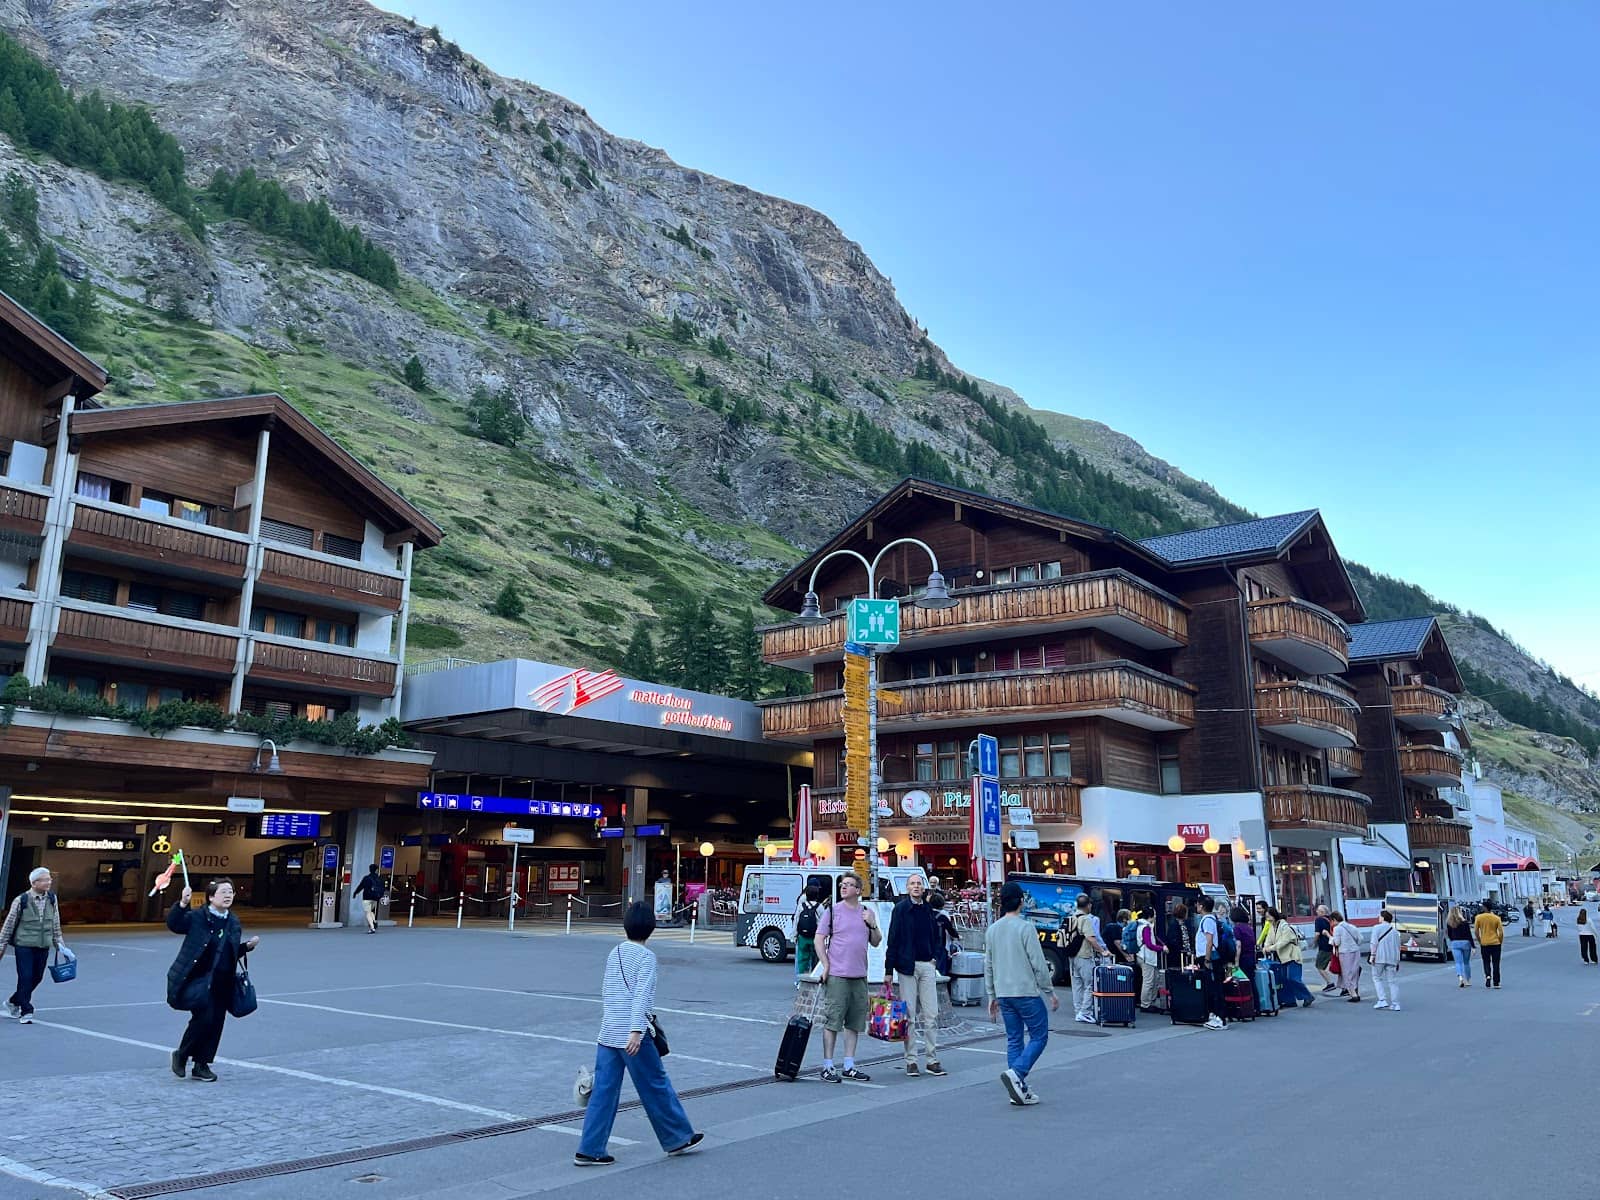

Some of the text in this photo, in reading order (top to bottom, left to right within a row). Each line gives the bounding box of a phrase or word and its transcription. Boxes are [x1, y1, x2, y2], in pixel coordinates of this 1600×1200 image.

[631, 689, 692, 709] matterhorn
[944, 791, 1021, 807] Pizia
[1182, 825, 1206, 835] ATM
[840, 833, 857, 841] ATM
[909, 831, 969, 841] Bahnhofbuf
[184, 854, 229, 867] come
